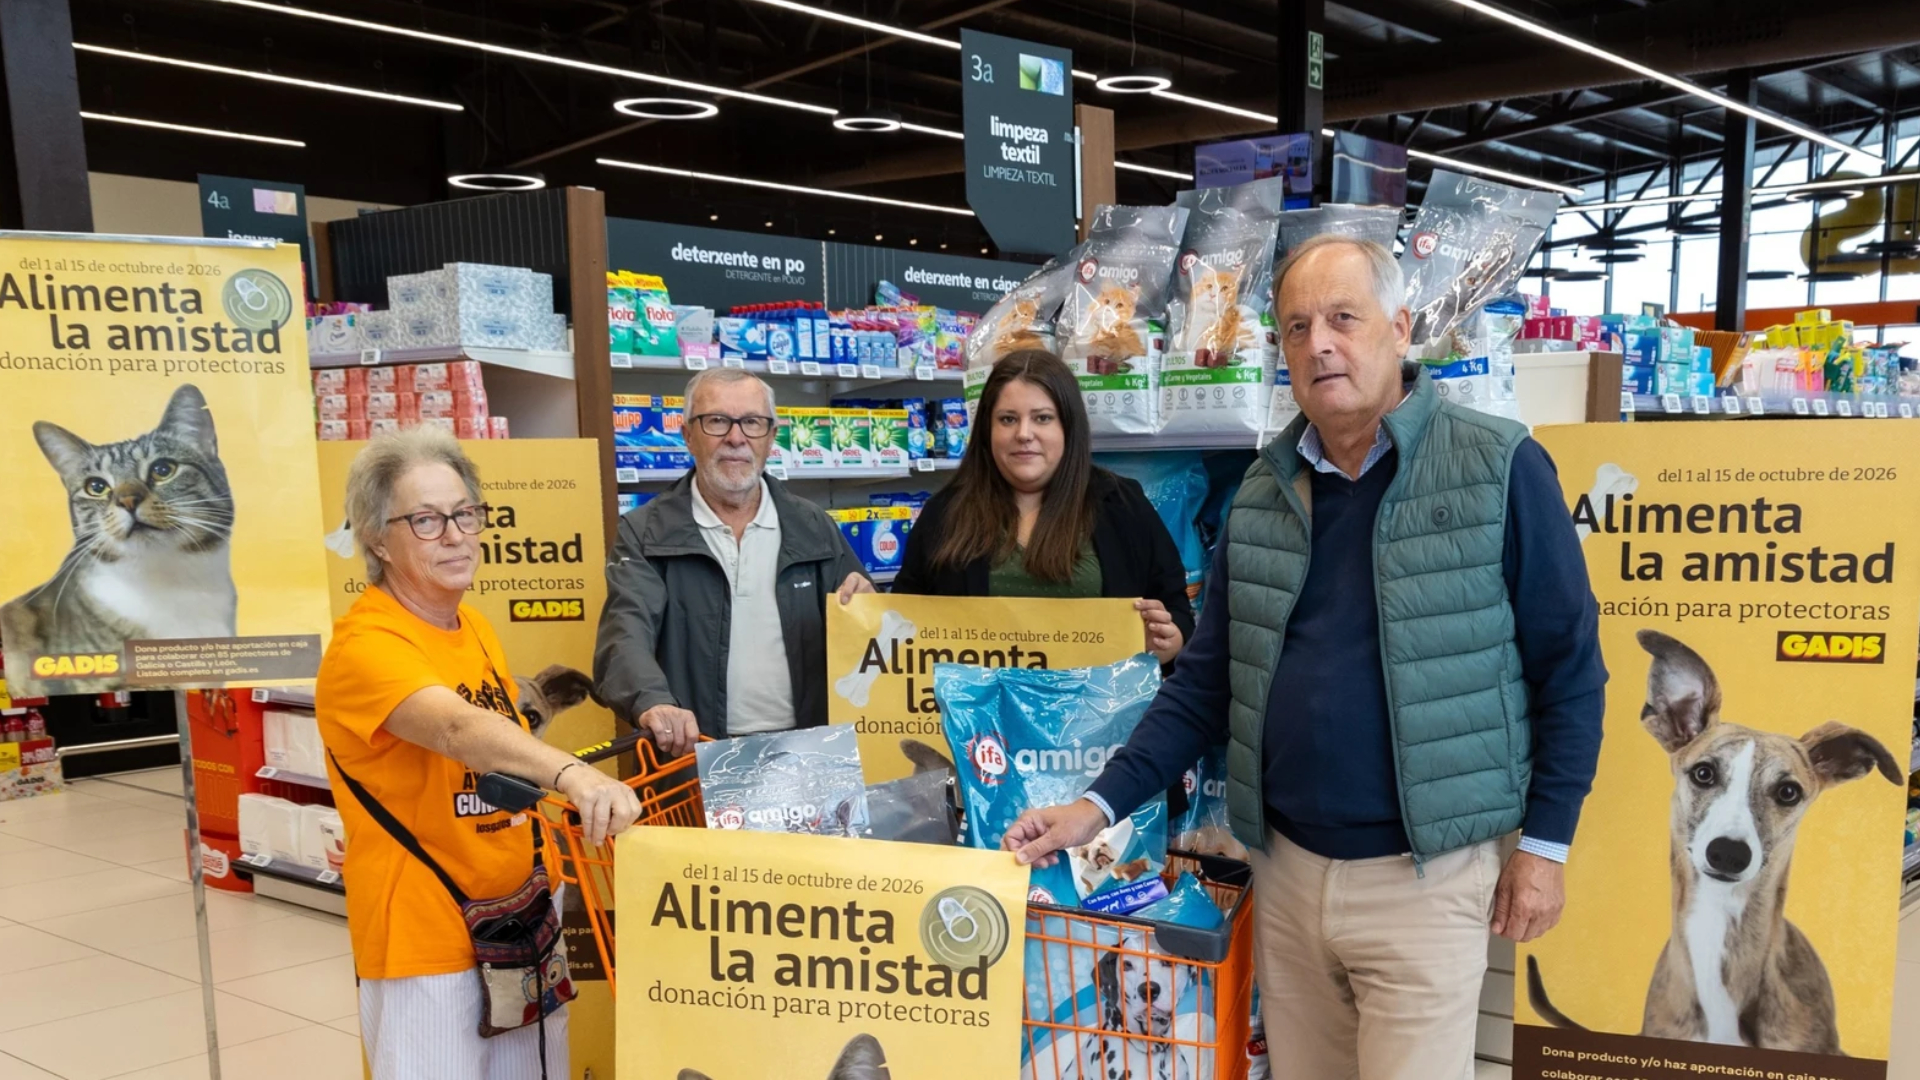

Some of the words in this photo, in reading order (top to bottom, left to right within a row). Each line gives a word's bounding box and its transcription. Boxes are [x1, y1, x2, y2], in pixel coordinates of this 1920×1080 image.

[971, 55, 994, 83] 3a
[990, 116, 1048, 144] limpeza
[1001, 142, 1040, 164] textil
[984, 165, 1025, 182] LIMPIEZA
[1026, 170, 1057, 186] TEXTIL
[207, 190, 230, 209] 4a
[20, 257, 41, 271] del
[45, 259, 51, 271] 1
[55, 258, 67, 271] al
[71, 260, 84, 272] 15
[88, 260, 105, 273] de
[109, 261, 163, 275] octubre
[167, 262, 184, 276] de
[187, 264, 221, 277] 2026
[671, 242, 760, 268] deterxente
[762, 256, 781, 270] en
[785, 257, 805, 277] po
[1201, 248, 1244, 267] amigo
[726, 269, 772, 282] DETERGENTE
[773, 274, 781, 283] en
[782, 275, 805, 286] POLVO
[904, 266, 972, 287] deterxente
[974, 276, 990, 289] en
[992, 275, 1020, 294] cáps
[1098, 263, 1138, 283] amigo
[0, 273, 203, 315] Alimenta
[50, 313, 90, 350] la
[107, 317, 281, 354] amistad
[0, 352, 103, 372] donación
[109, 357, 157, 376] para
[164, 358, 285, 376] protectoras
[484, 480, 527, 491] octubre
[530, 479, 544, 490] de
[547, 480, 576, 490] 2026
[1658, 468, 1682, 483] del
[1686, 469, 1693, 482] 1
[1696, 468, 1711, 482] al
[1715, 469, 1732, 482] 15
[1735, 468, 1756, 482] de
[1758, 468, 1824, 482] octubre
[1828, 467, 1850, 482] de
[1854, 467, 1897, 482] 2026
[1572, 493, 1803, 534] Alimenta
[480, 533, 583, 564] istad
[1620, 542, 1664, 582] la
[1681, 542, 1895, 584] amistad
[480, 577, 585, 595] protectoras
[512, 600, 583, 619] GADIS
[1596, 597, 1669, 618] ación
[1676, 603, 1732, 622] para
[1738, 600, 1891, 624] protectoras
[920, 627, 939, 640] del
[942, 628, 948, 640] 1
[950, 627, 962, 640] al
[965, 628, 978, 640] 15
[980, 628, 997, 642] de
[1000, 630, 1049, 643] octubre
[1053, 630, 1070, 644] de
[1072, 632, 1104, 644] 2026
[1782, 634, 1883, 659] GADIS
[135, 645, 158, 654] Dona
[159, 644, 198, 654] producto
[200, 643, 214, 653] y/o
[216, 642, 230, 651] haz
[232, 641, 277, 651] aportación
[291, 640, 308, 649] caja
[136, 654, 156, 663] para
[157, 652, 198, 662] colaborar
[200, 652, 216, 660] con
[230, 650, 280, 659] protectoras
[859, 637, 1048, 674] Alimenta
[34, 654, 118, 677] GADIS
[136, 661, 166, 670] Galicia
[174, 660, 206, 669] Castilla
[208, 661, 214, 669] y
[215, 659, 238, 667] León.
[137, 669, 168, 678] Listado
[170, 668, 211, 677] completo
[225, 666, 259, 676] gadis.es
[981, 745, 1003, 767] ifa
[722, 814, 740, 826] ifa
[748, 803, 816, 825] amigo
[682, 864, 708, 880] del
[712, 866, 720, 880] 1
[722, 866, 738, 882] al
[742, 868, 760, 884] 15
[764, 868, 784, 885] de
[787, 870, 853, 890] octubre
[856, 875, 878, 892] de
[882, 878, 924, 895] 2026
[650, 882, 895, 946] Alimenta
[562, 926, 576, 936] aja
[568, 961, 594, 969] dis.es
[710, 935, 755, 984] la
[774, 946, 989, 1001] amistad
[648, 980, 767, 1012] donación
[772, 994, 832, 1018] para
[838, 998, 991, 1028] protectoras
[1542, 1046, 1575, 1059] Dona
[1578, 1052, 1638, 1065] producto
[1640, 1057, 1662, 1068] y/o
[1664, 1058, 1687, 1071] haz
[1690, 1062, 1764, 1079] aportación
[1767, 1071, 1784, 1080] en
